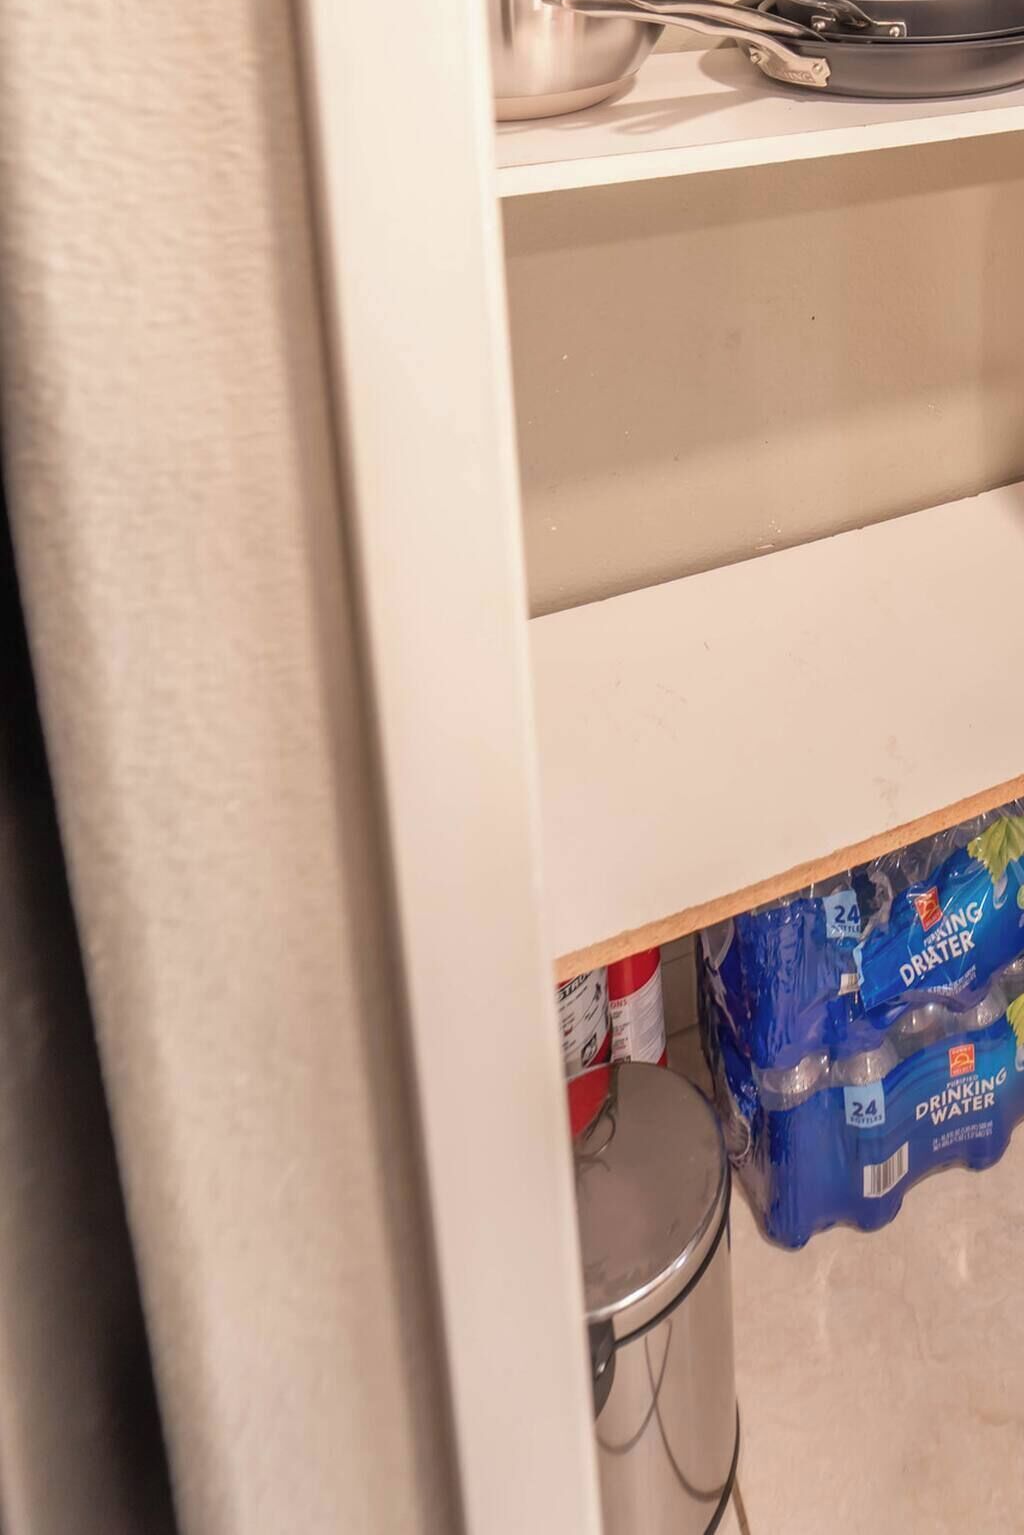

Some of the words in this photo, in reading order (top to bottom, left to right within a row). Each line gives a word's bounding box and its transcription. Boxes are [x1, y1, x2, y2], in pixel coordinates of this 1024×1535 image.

[834, 905, 861, 924] 24
[915, 1066, 1008, 1121] DRINKING
[852, 1098, 878, 1117] 24
[931, 1092, 995, 1126] WATER
